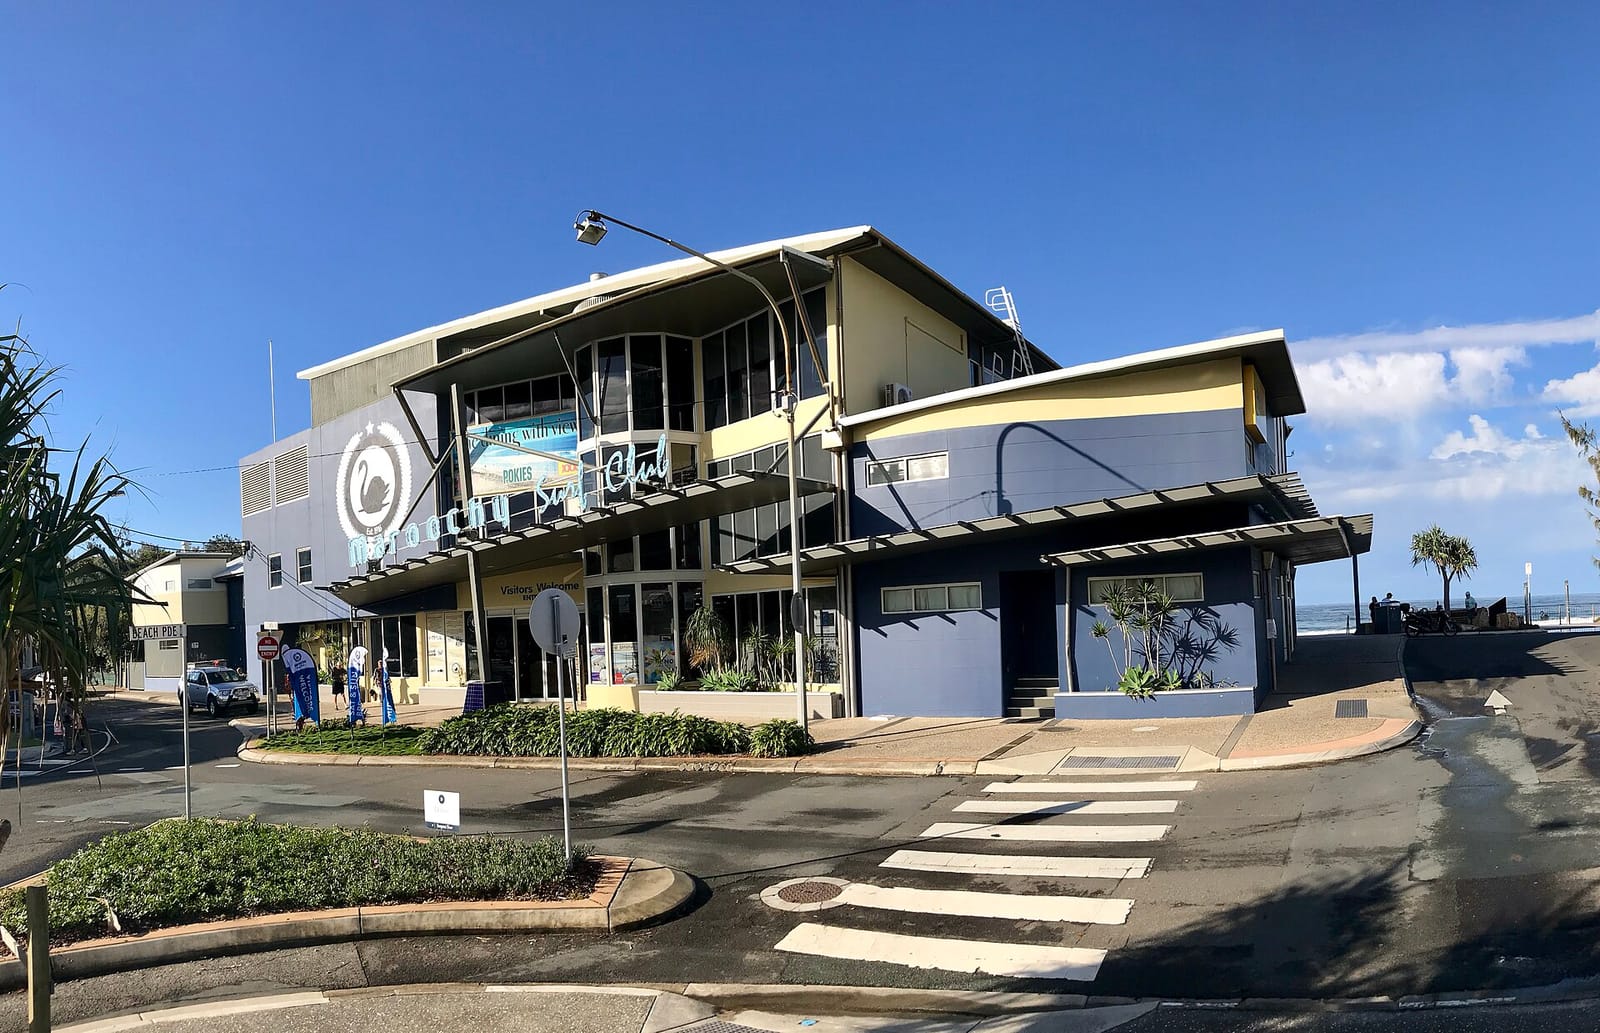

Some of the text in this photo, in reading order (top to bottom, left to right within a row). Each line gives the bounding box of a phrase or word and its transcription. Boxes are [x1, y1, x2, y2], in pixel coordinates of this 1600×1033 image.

[522, 418, 549, 440] with
[605, 433, 670, 493] Club
[503, 466, 533, 484] POKIES
[501, 581, 580, 595] Visitors Welcome
[132, 625, 178, 639] BEACH PDE
